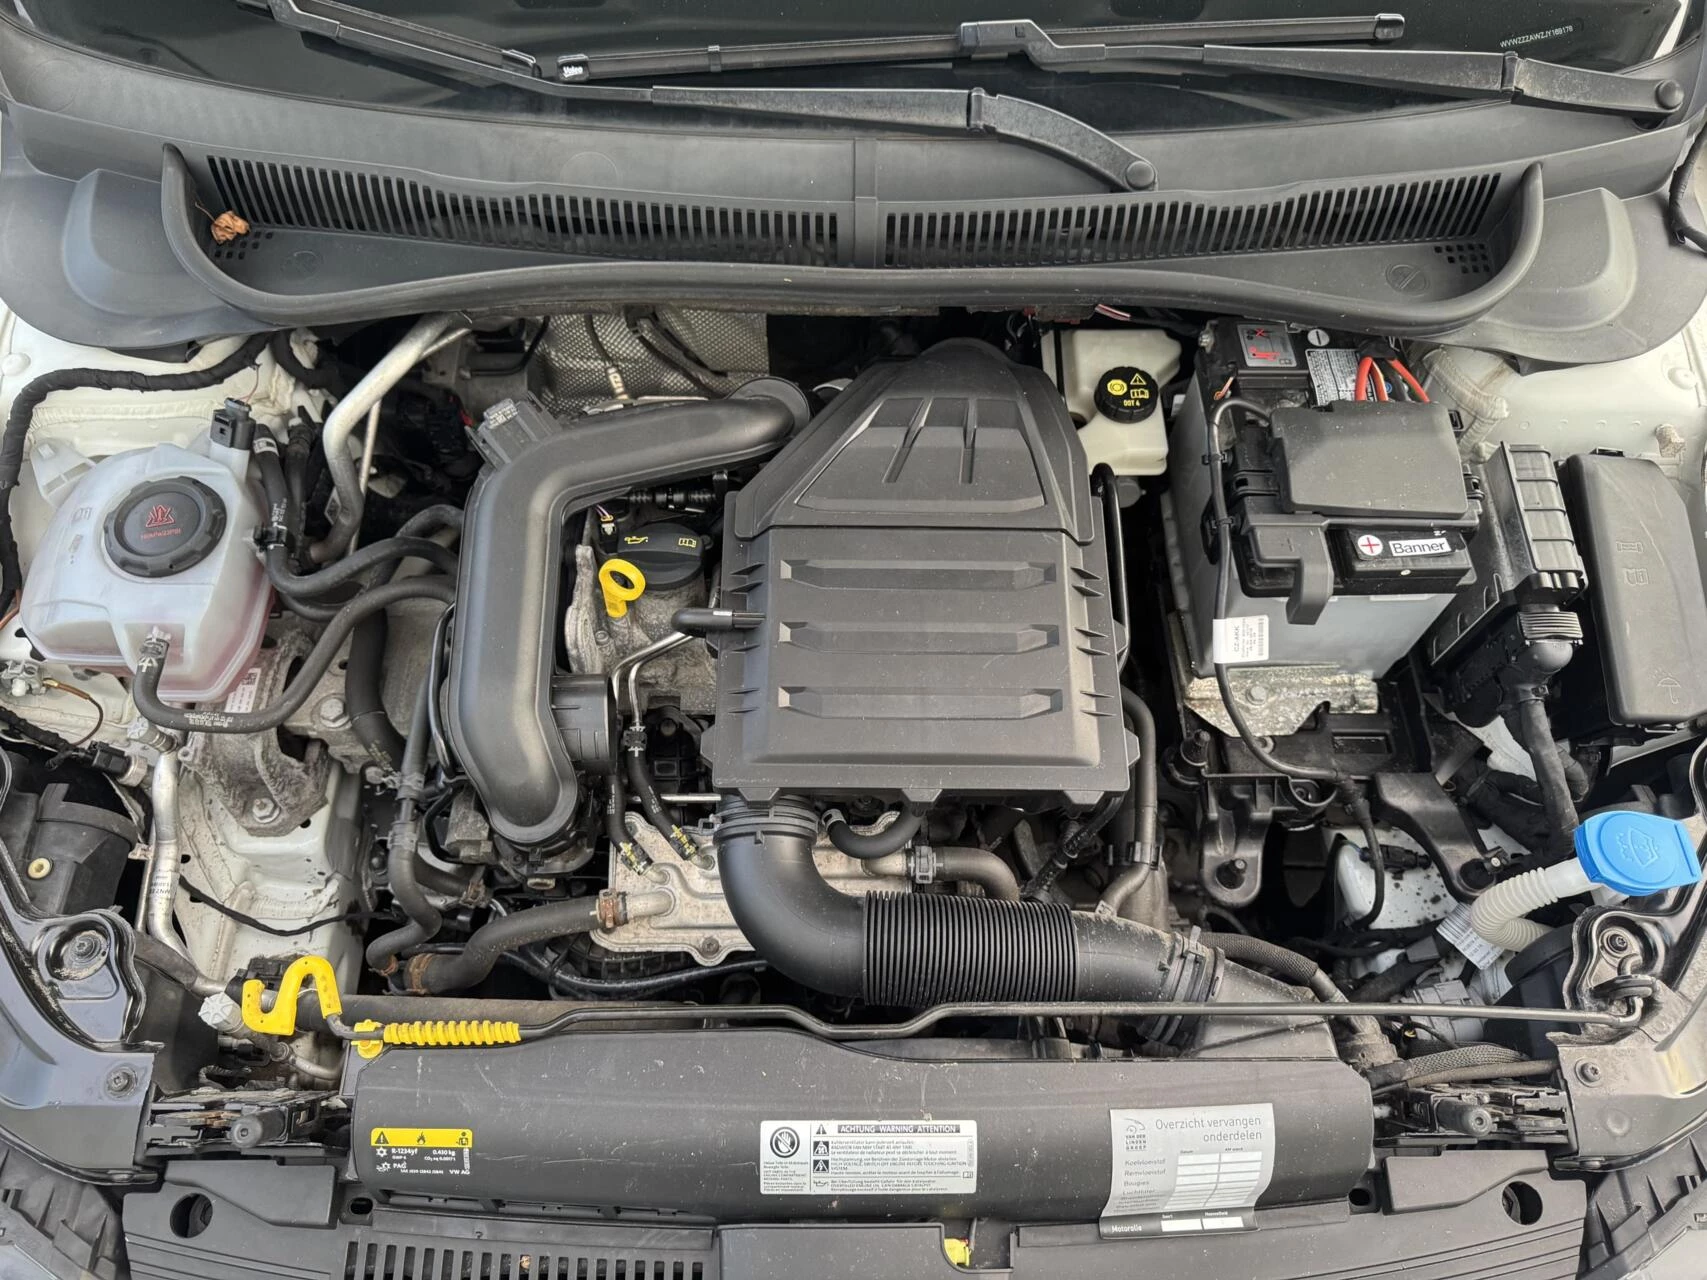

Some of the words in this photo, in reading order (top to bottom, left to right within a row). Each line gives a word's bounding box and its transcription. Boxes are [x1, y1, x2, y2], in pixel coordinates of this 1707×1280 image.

[562, 65, 584, 75] Valeo
[1391, 541, 1446, 554] Banner
[1155, 1118, 1204, 1130] Overzicht
[1207, 1117, 1262, 1129] vervangen
[840, 1125, 876, 1133] ACHTUNG
[879, 1125, 914, 1133] WARNING
[917, 1125, 956, 1133] ATTENTION
[1203, 1131, 1262, 1142] onderdelen
[391, 1148, 418, 1158] R-1234yf
[1111, 1224, 1142, 1233] Motorolie
